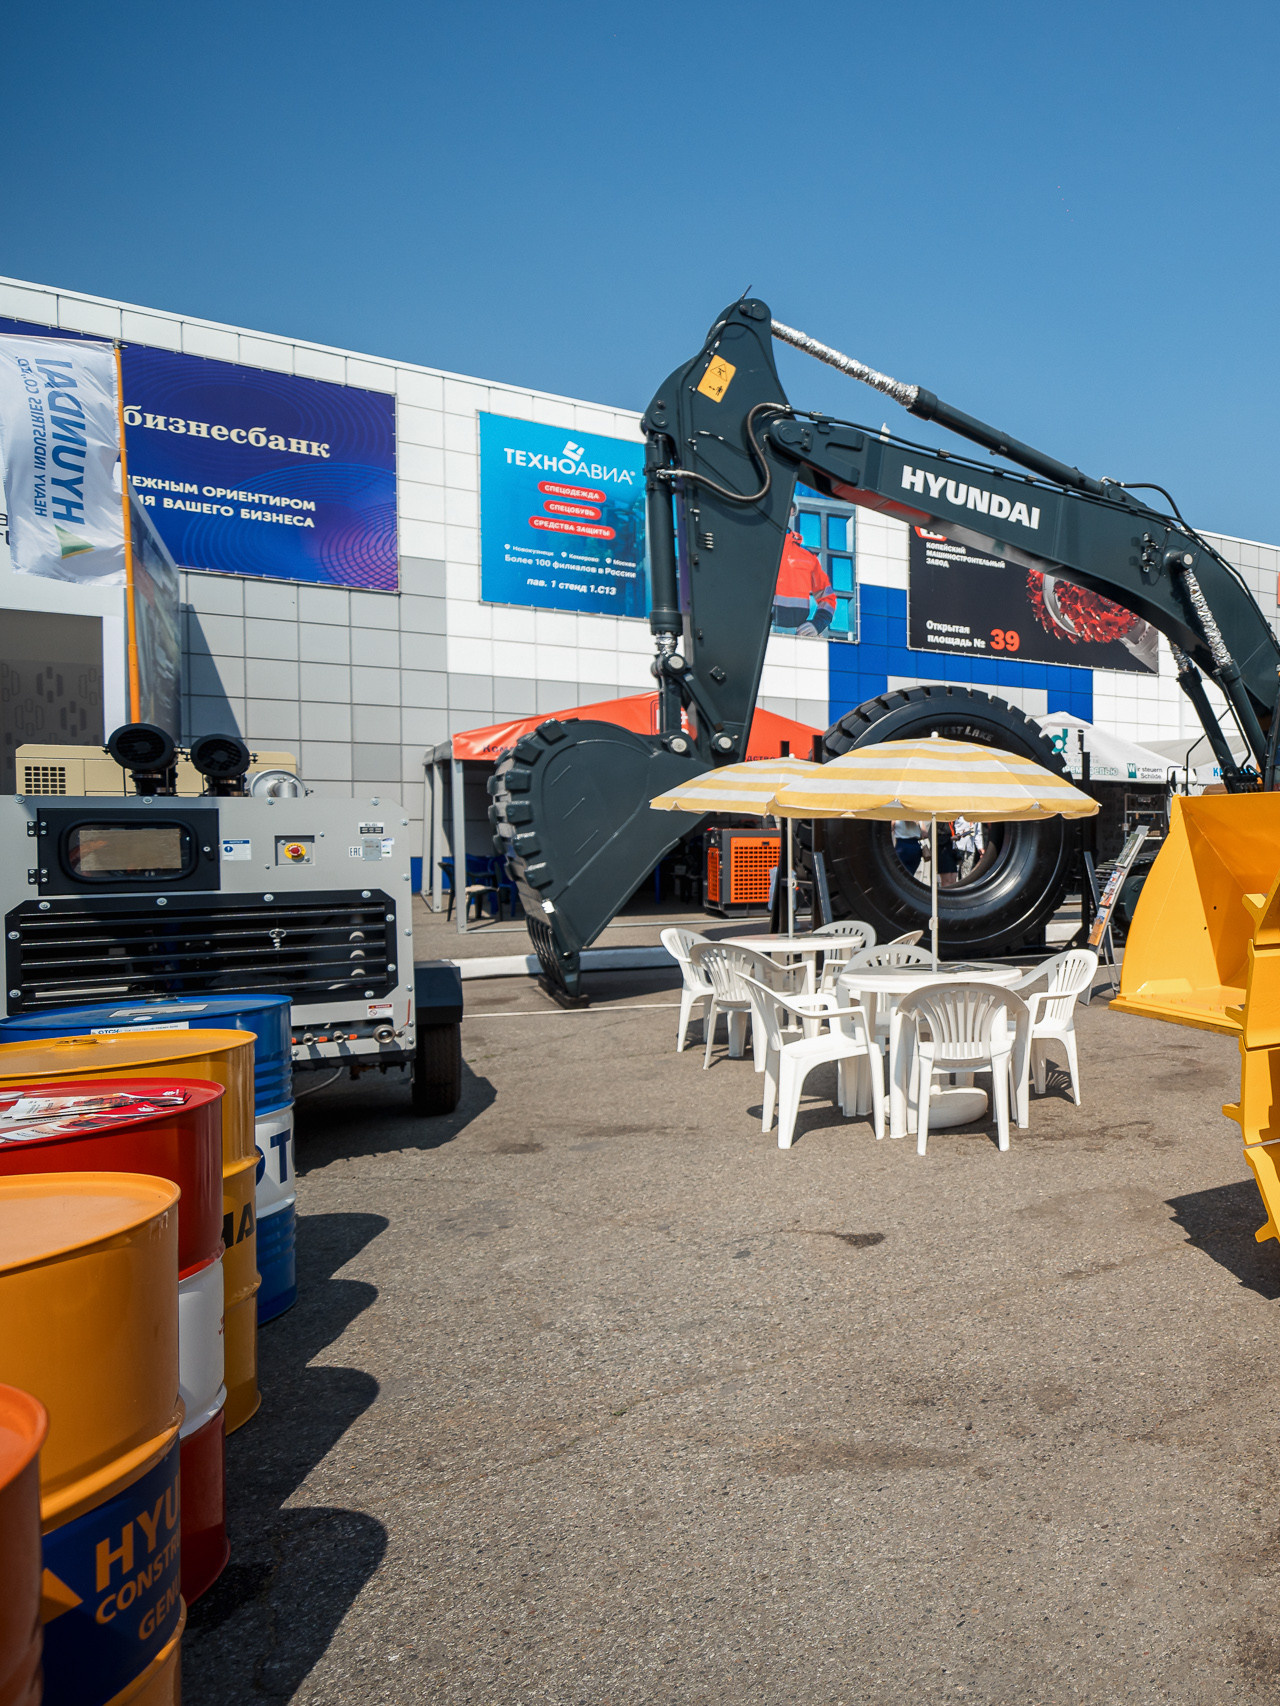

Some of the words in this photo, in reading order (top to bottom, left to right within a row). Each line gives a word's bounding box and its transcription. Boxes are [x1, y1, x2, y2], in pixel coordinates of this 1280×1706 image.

[123, 404, 331, 459] бизнесбанк
[127, 475, 199, 495] ЕЖНЫМ
[202, 486, 316, 512] ОРИЕНТИРОМ
[544, 484, 600, 500] СПЕЦОДЕЖДА
[901, 464, 1040, 530] HYUNDAI
[163, 497, 234, 517] ВАШЕГО
[240, 508, 315, 528] БИЗНЕСА
[549, 503, 596, 517] СПЕЦОБУВЬ
[533, 519, 575, 532] СРЕДСТВА
[576, 525, 611, 537] ЗАЩИТЫ
[925, 541, 967, 555] КОПЕЙСКИЙ
[504, 554, 533, 565] Более
[536, 558, 551, 568] 100
[552, 560, 598, 574] филиалов
[597, 567, 604, 575] в
[604, 567, 637, 579] России
[925, 549, 1006, 569] МАШИНОСТРОИТЕЛЬНЫЙ
[925, 557, 950, 568] ЗАВОД
[526, 577, 548, 588] пав.
[550, 579, 557, 588] 1
[558, 581, 588, 594] стенд
[589, 584, 617, 596] 1.С13
[925, 619, 971, 635] Открытая
[927, 634, 973, 648] площадь
[973, 637, 987, 649] №
[989, 628, 1021, 652] 39
